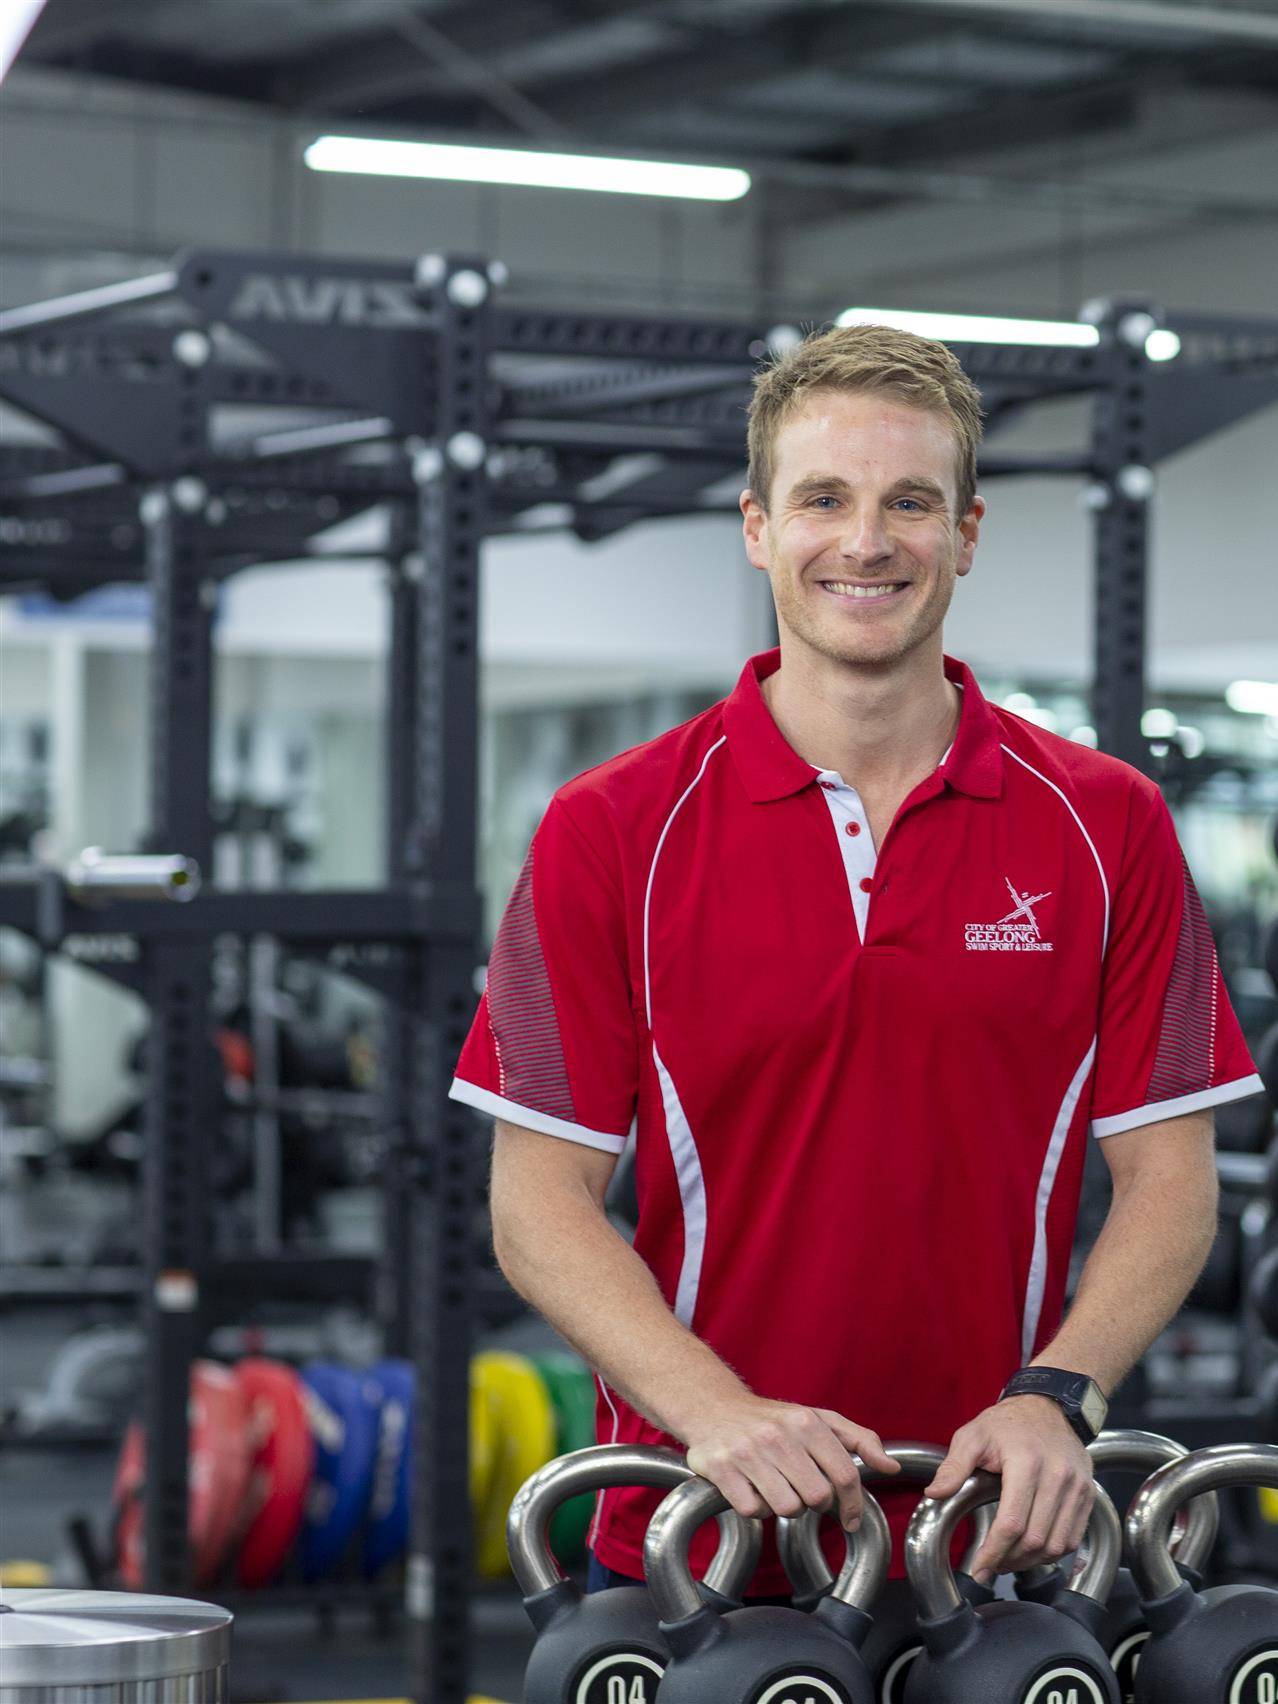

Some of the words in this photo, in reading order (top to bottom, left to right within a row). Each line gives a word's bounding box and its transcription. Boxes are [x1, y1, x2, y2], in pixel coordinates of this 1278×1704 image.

[965, 923, 985, 931] CITY
[986, 923, 998, 931] OF
[964, 930, 1036, 943] GEELONG
[966, 943, 988, 951] SWIM
[989, 943, 1014, 951] SPORT
[1022, 943, 1053, 951] LEISURE
[607, 1675, 647, 1704] 04
